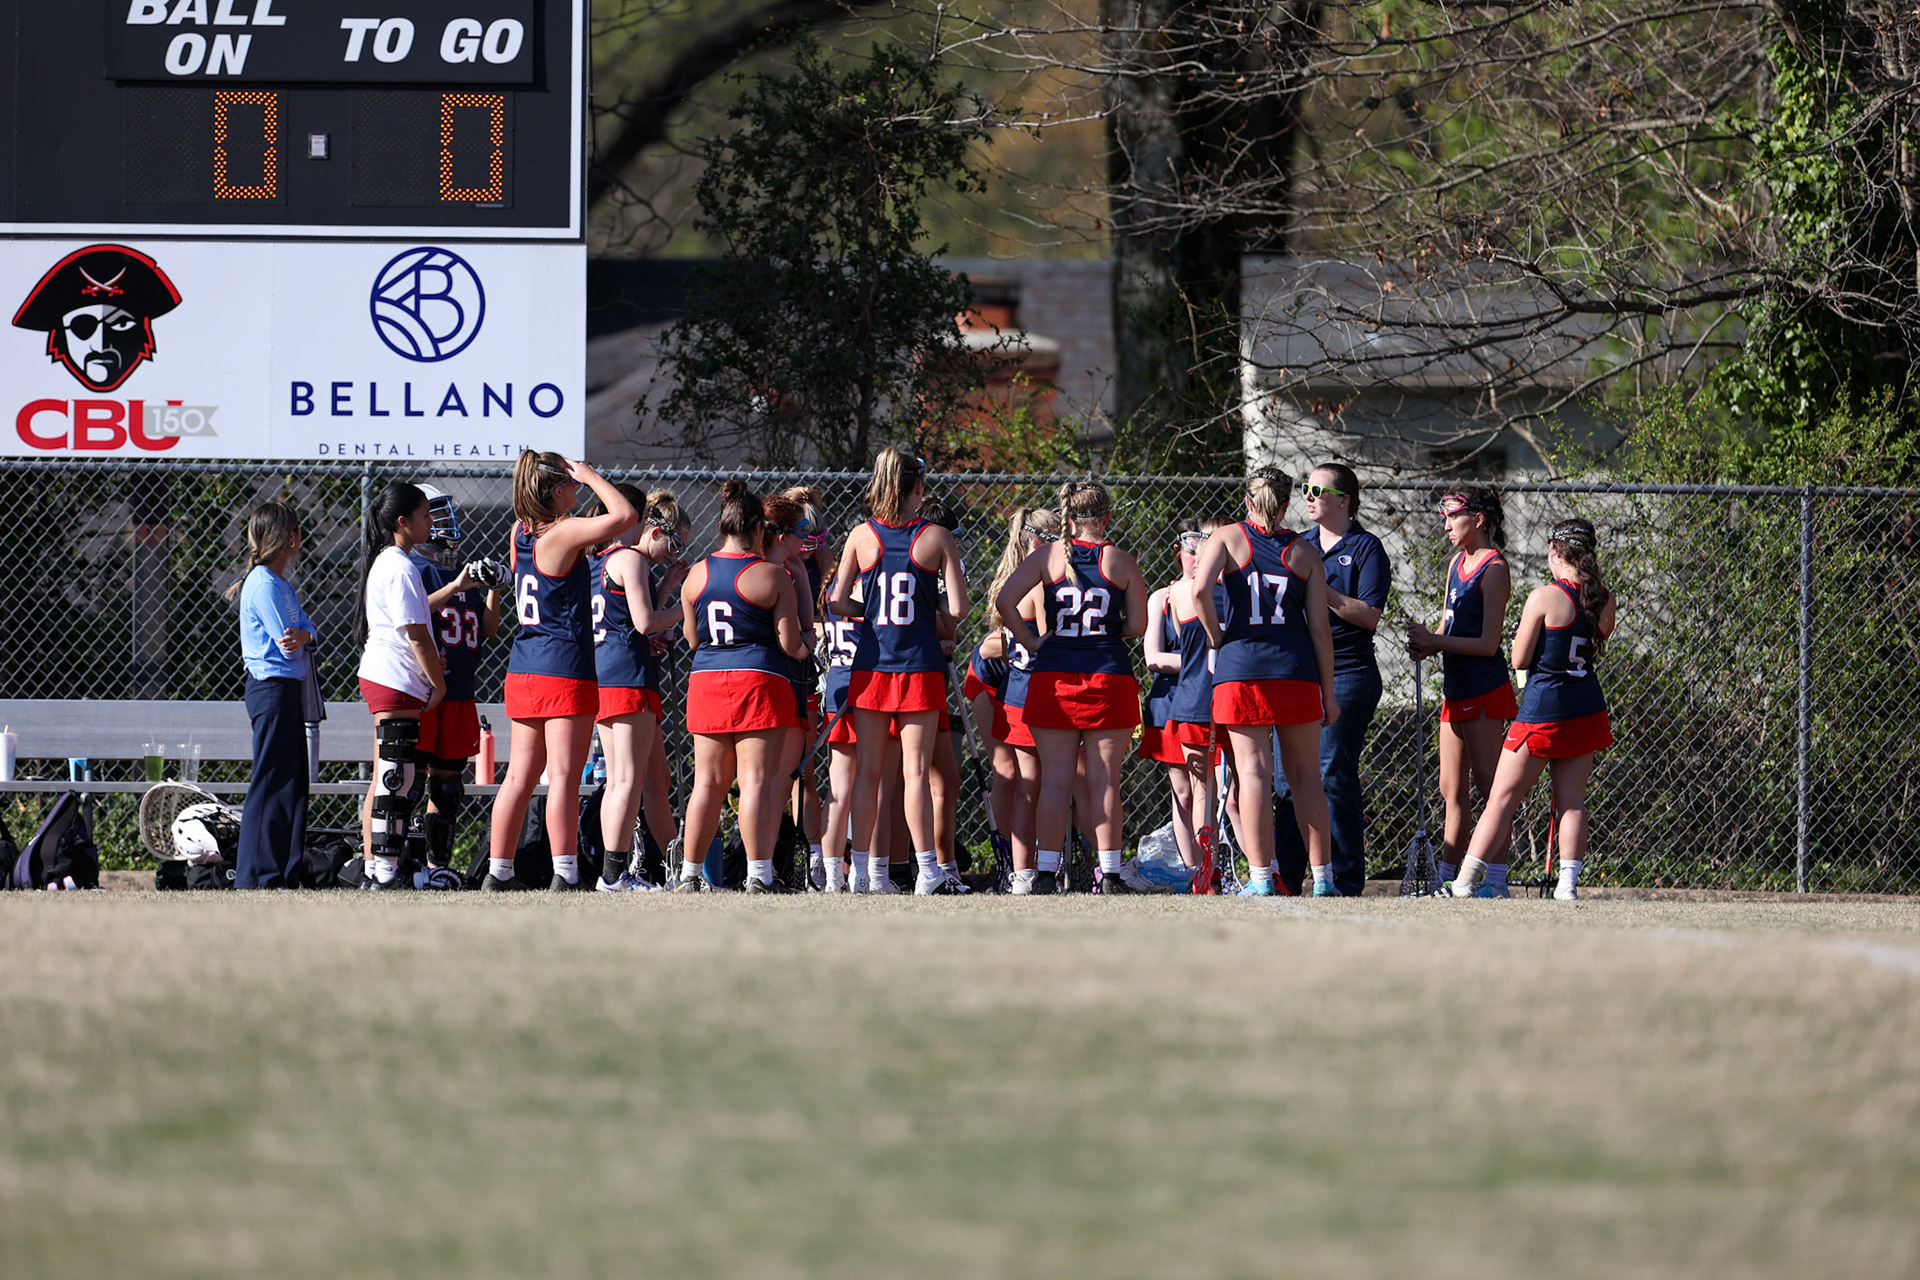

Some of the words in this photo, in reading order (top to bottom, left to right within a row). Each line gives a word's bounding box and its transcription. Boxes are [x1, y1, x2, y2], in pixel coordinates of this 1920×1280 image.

[125, 0, 287, 26] BALL
[164, 32, 253, 76] ON
[340, 17, 416, 64] TO
[439, 17, 525, 64] GO
[214, 91, 277, 199] 0
[440, 93, 504, 202] 0
[152, 408, 205, 434] 150
[290, 381, 565, 419] BELLANO
[15, 398, 186, 451] CBU
[318, 443, 415, 456] DENTAL
[433, 444, 530, 457] HEALTH
[876, 571, 917, 626] 18
[1055, 586, 1111, 638] 22
[1246, 570, 1289, 625] 17
[439, 605, 480, 651] 33
[706, 600, 735, 646] 6
[1568, 635, 1588, 678] 5
